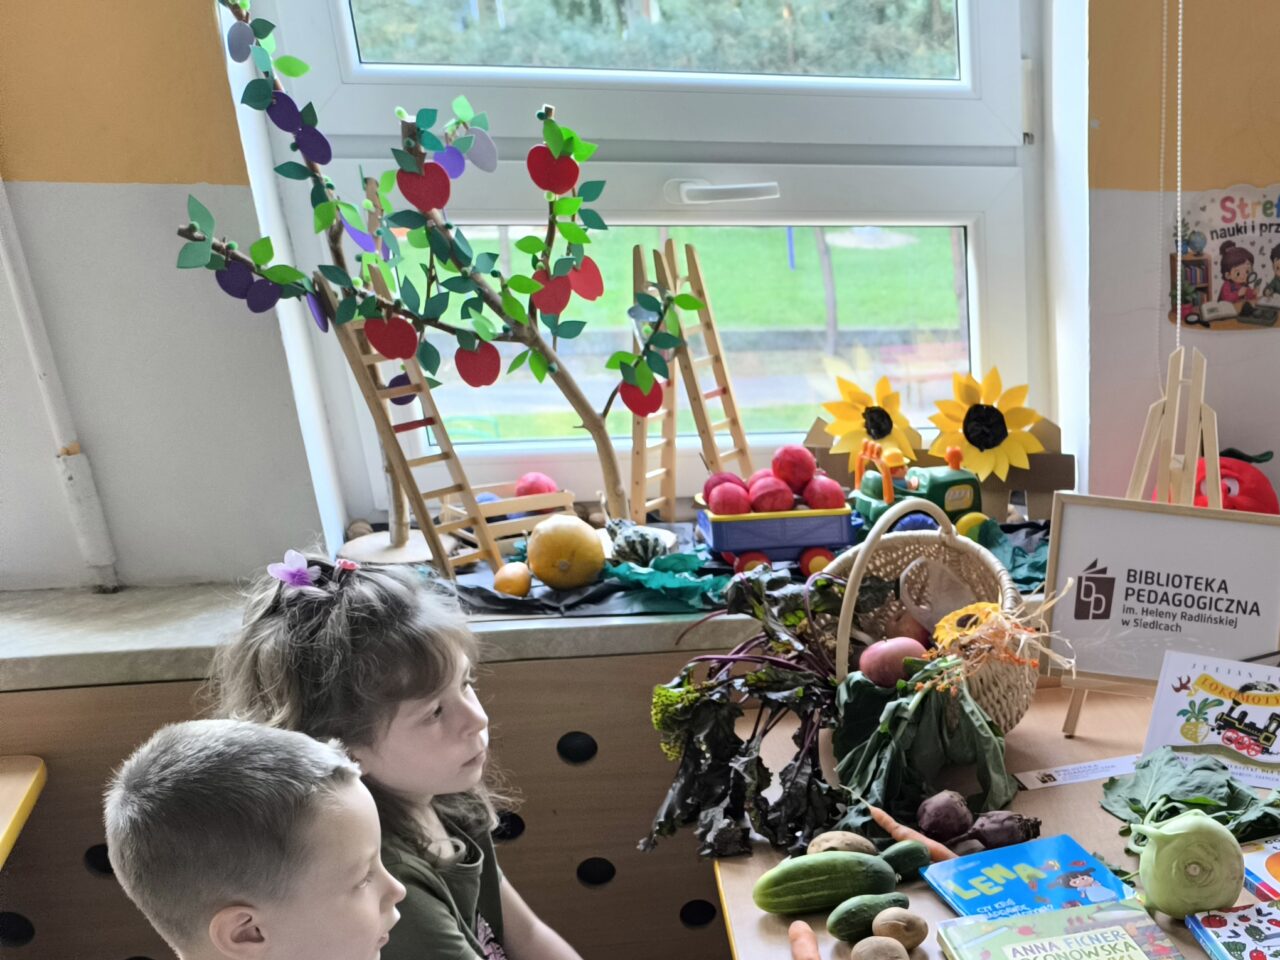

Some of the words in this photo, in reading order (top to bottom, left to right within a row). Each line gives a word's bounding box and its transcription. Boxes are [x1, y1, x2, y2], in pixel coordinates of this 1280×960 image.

[1209, 221, 1248, 241] nauki
[1251, 221, 1255, 234] i
[1126, 568, 1229, 595] BIBLIOTEKA
[1124, 586, 1261, 617] PEDAGOGICZNA
[1121, 619, 1131, 627] w
[1133, 618, 1182, 633] Siedlcach
[1122, 604, 1138, 616] im.
[1141, 606, 1177, 621] Heleny
[1180, 610, 1238, 629] Radlińskiej
[1012, 941, 1061, 959] ANNA
